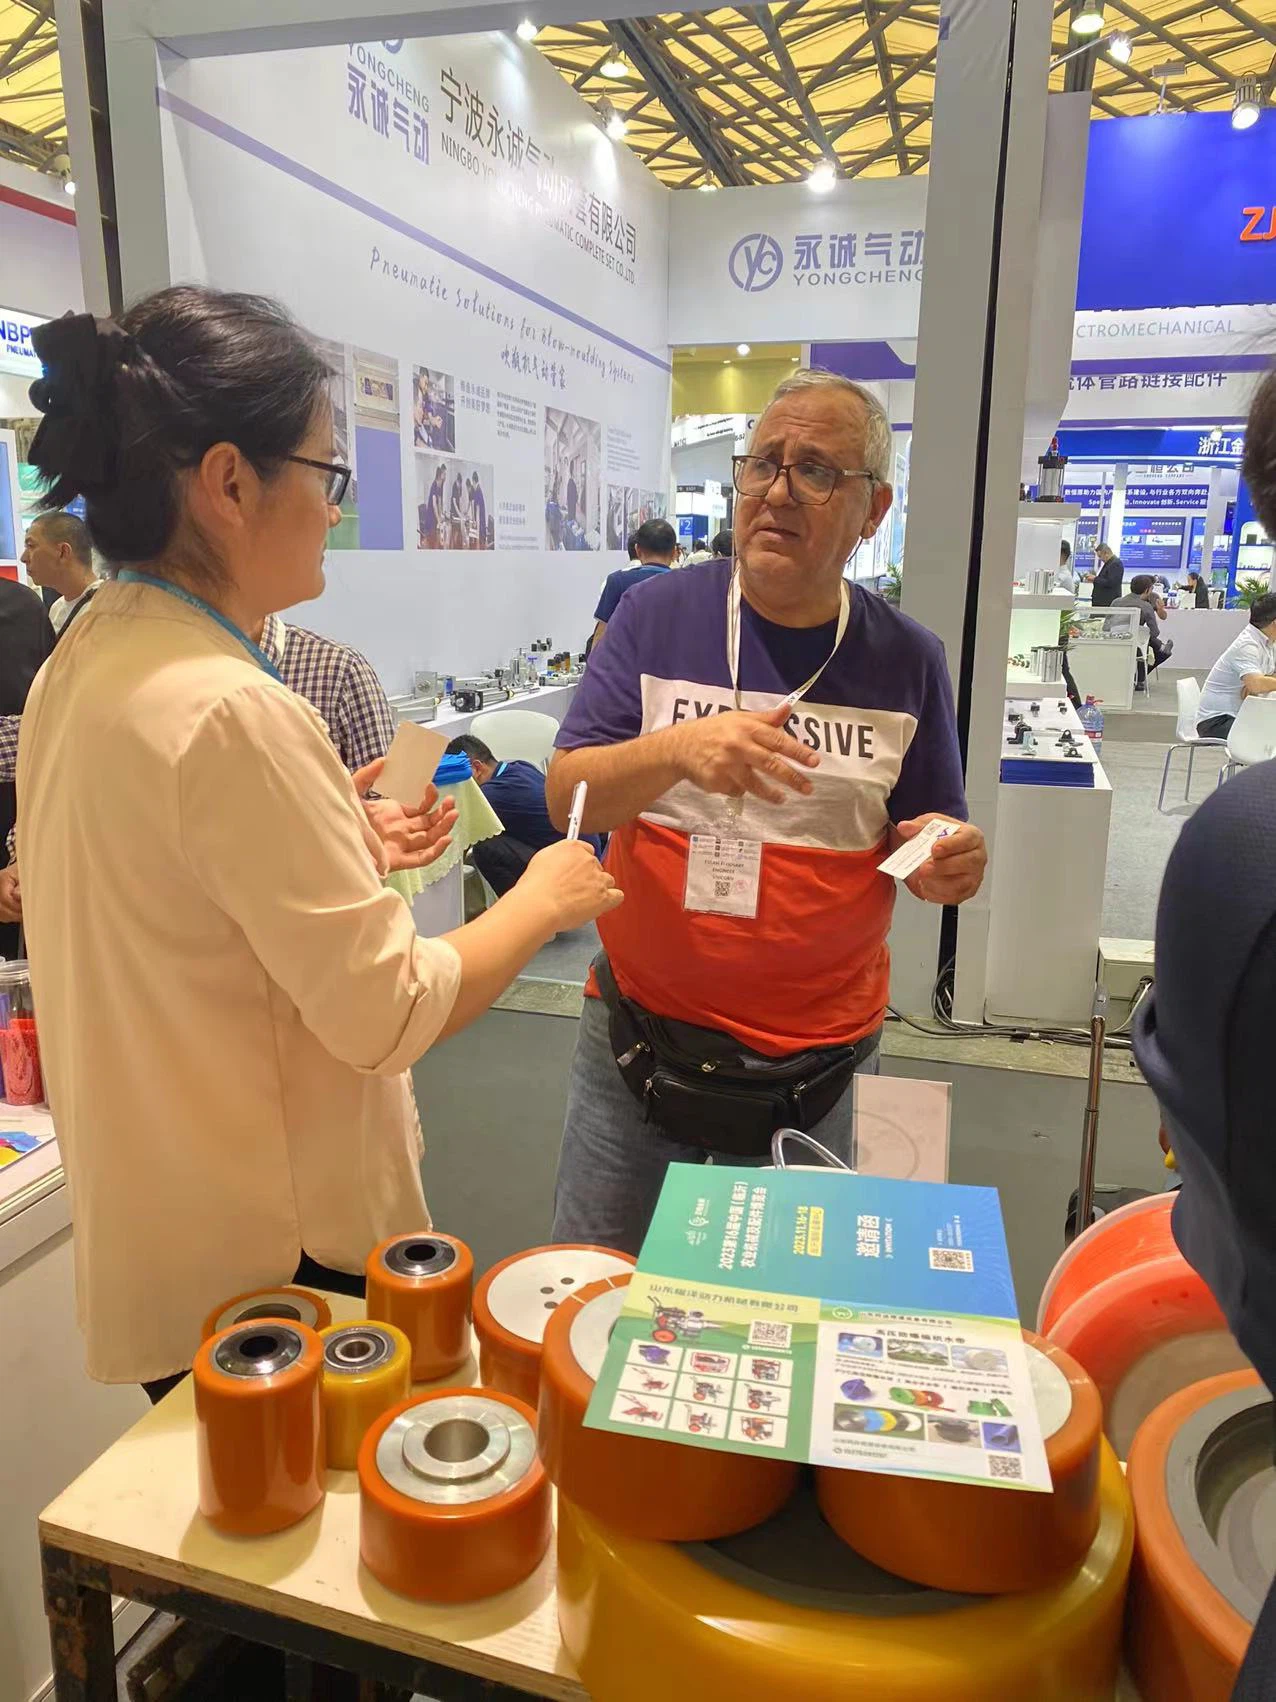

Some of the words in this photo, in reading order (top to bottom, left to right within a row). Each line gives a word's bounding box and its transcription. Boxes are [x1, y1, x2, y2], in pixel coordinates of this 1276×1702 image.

[349, 42, 430, 113] YONGCHENG
[347, 62, 430, 165] 永诚气动
[441, 132, 479, 176] NINGBO
[793, 229, 924, 271] 永诚气动
[370, 246, 448, 300] Pneumatic
[520, 317, 536, 339] for
[855, 1215, 881, 1258] 邀请函
